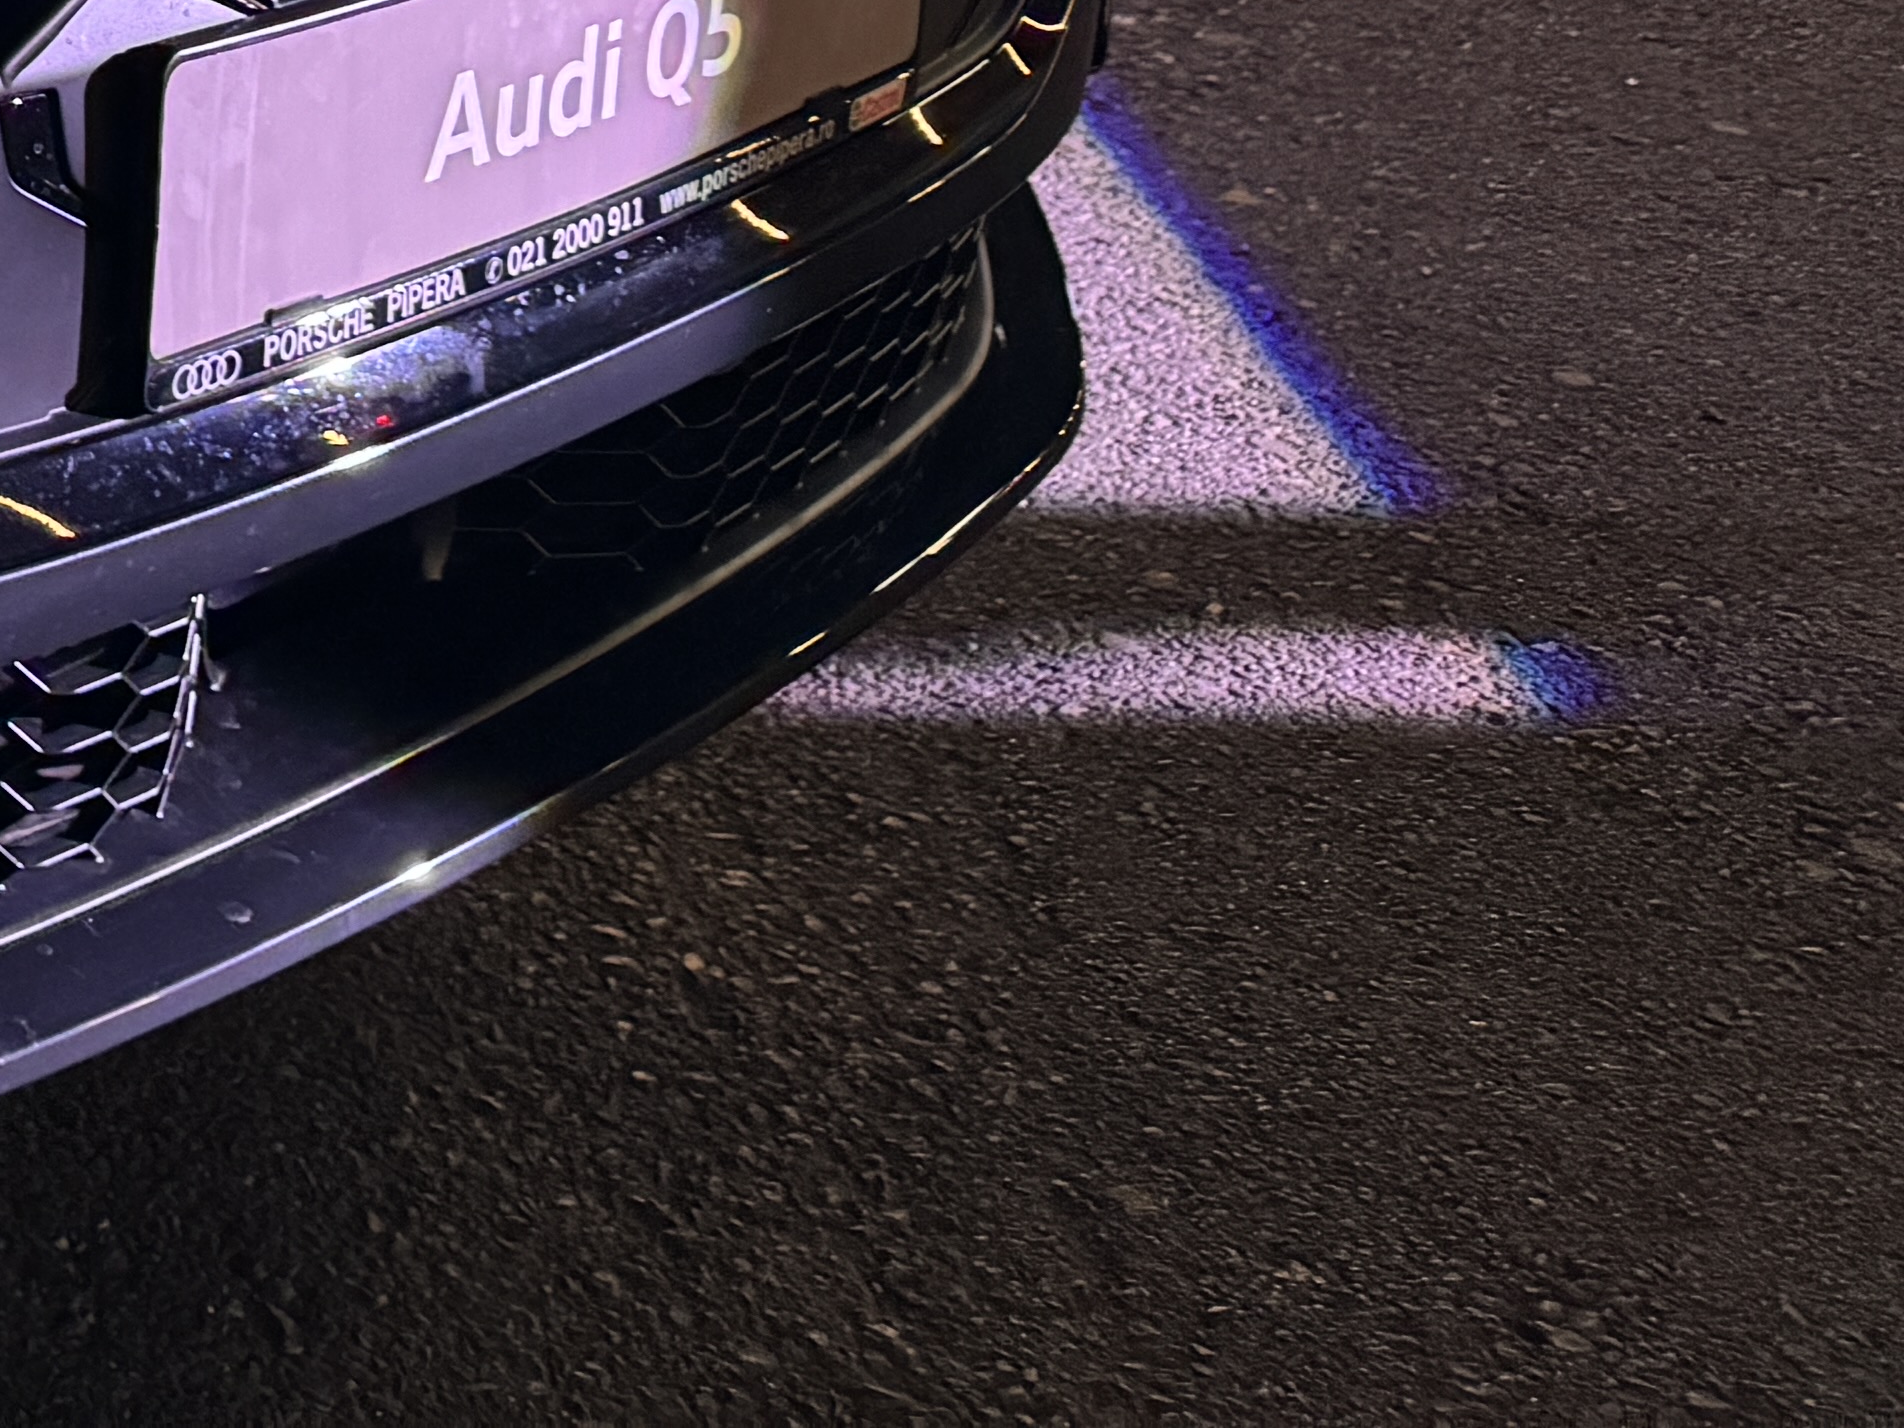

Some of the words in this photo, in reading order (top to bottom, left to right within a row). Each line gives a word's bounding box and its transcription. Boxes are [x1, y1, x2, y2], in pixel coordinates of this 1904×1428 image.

[424, 18, 623, 183] Audi
[263, 297, 376, 368] PORSCHE
[386, 268, 466, 323] PIPERA
[507, 236, 547, 276] 021
[552, 213, 604, 260] 2000
[607, 196, 645, 237] 911
[659, 119, 836, 215] www.porschepipera.ro
